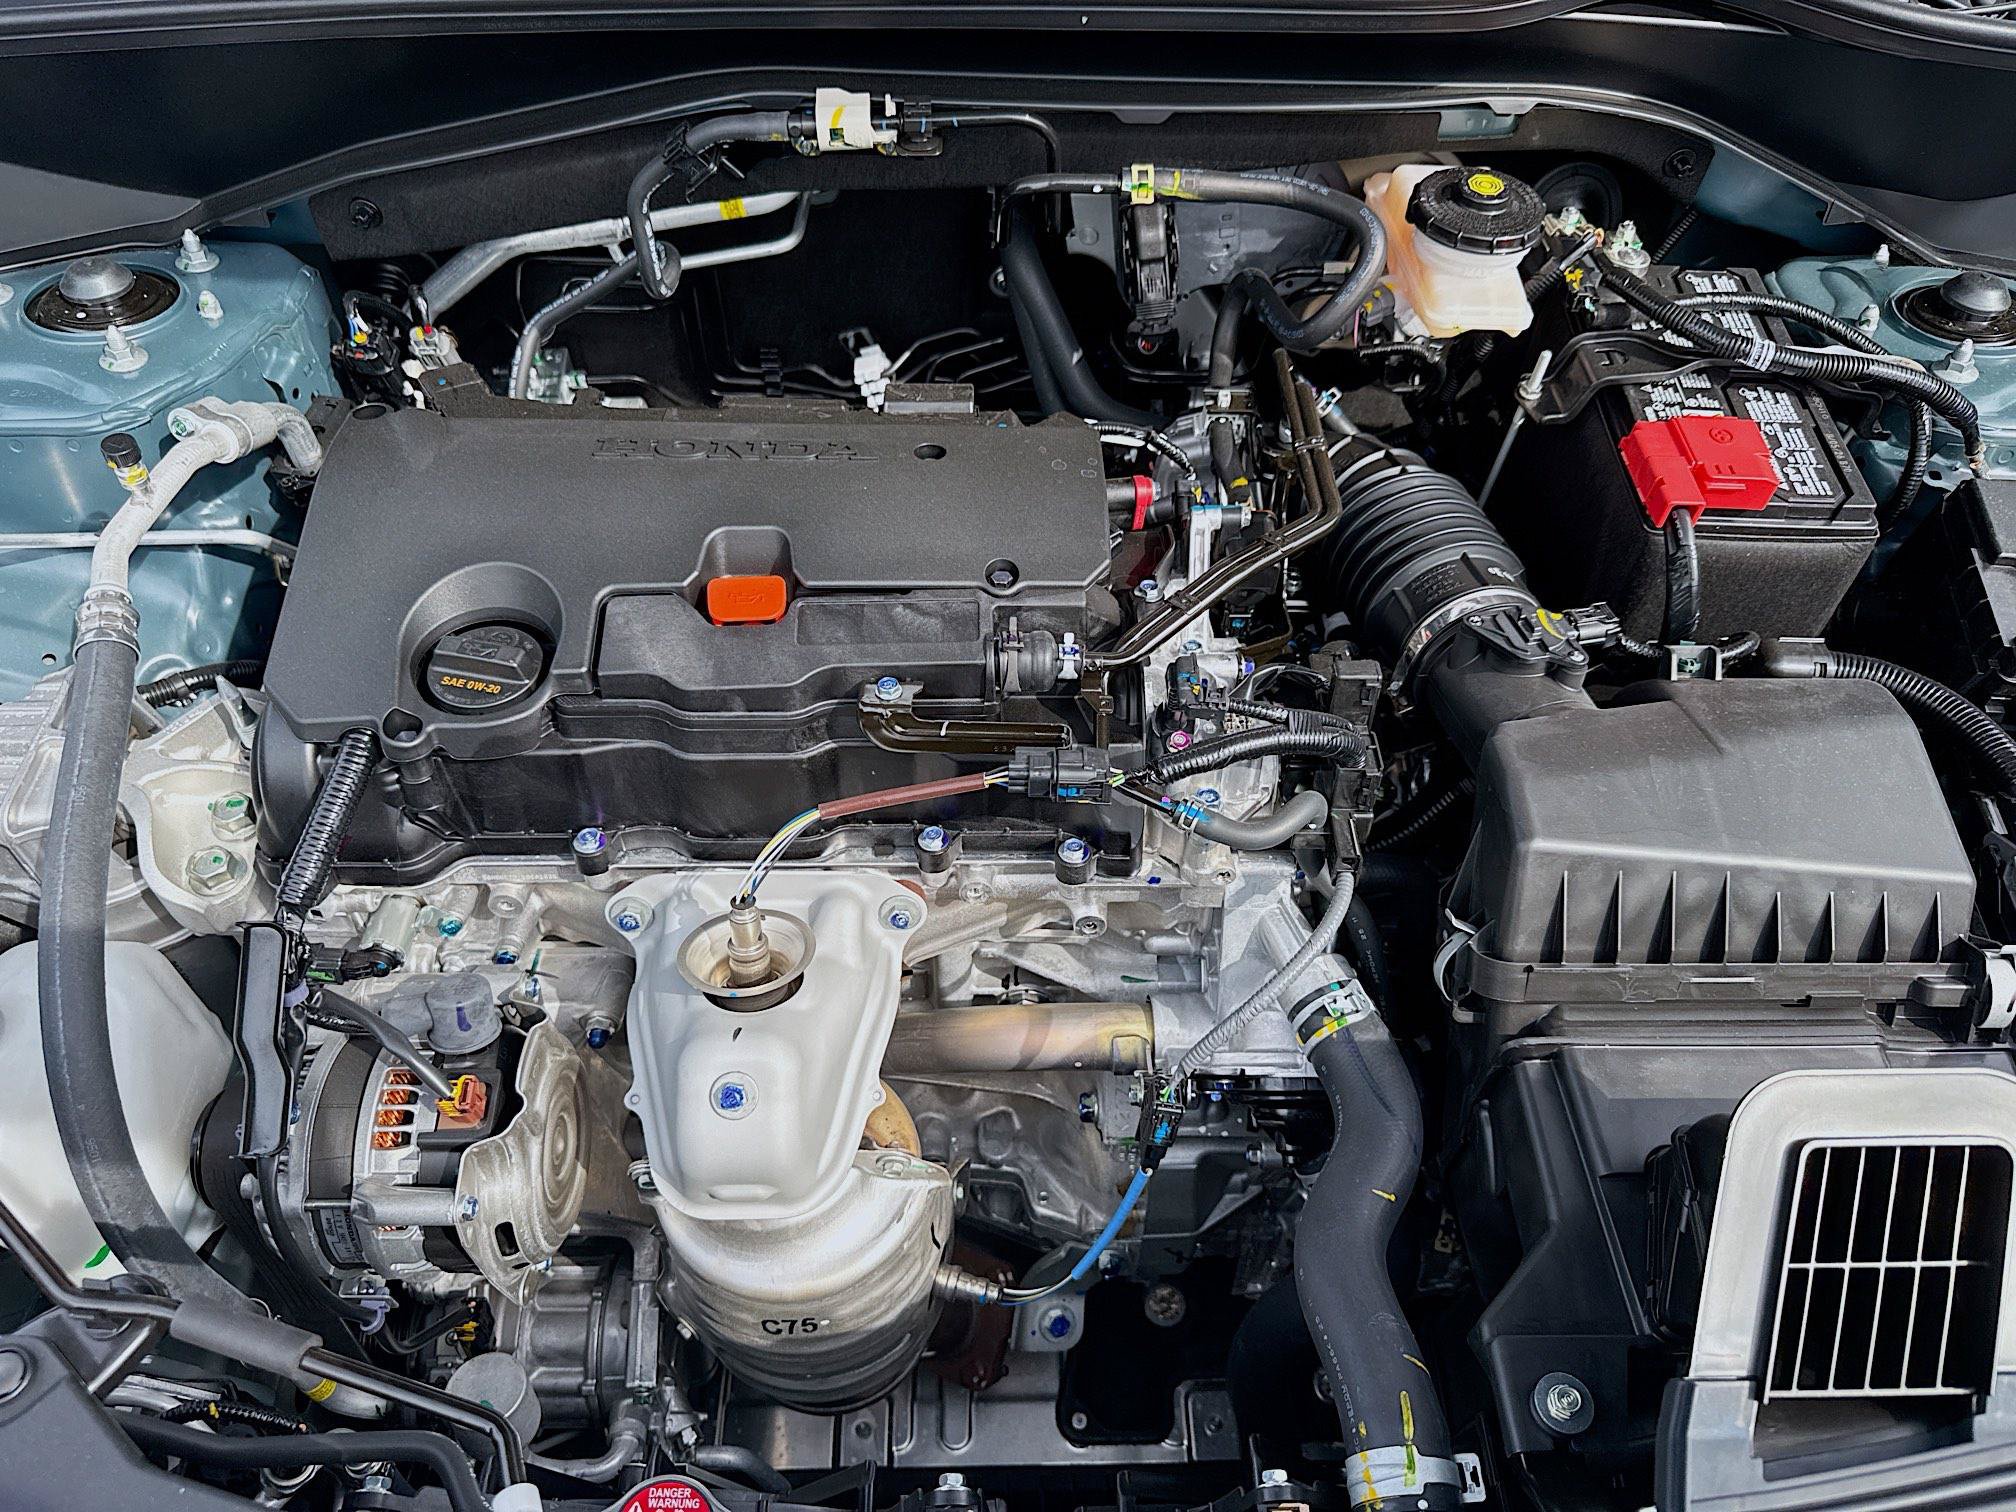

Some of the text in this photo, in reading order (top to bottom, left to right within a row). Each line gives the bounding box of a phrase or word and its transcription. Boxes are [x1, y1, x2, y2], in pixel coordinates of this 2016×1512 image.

[592, 439, 878, 460] HONDA
[440, 676, 502, 694] SAE 0W-20
[761, 1317, 818, 1335] C75
[648, 1487, 691, 1499] DANGER
[647, 1498, 700, 1509] WARNUNG
